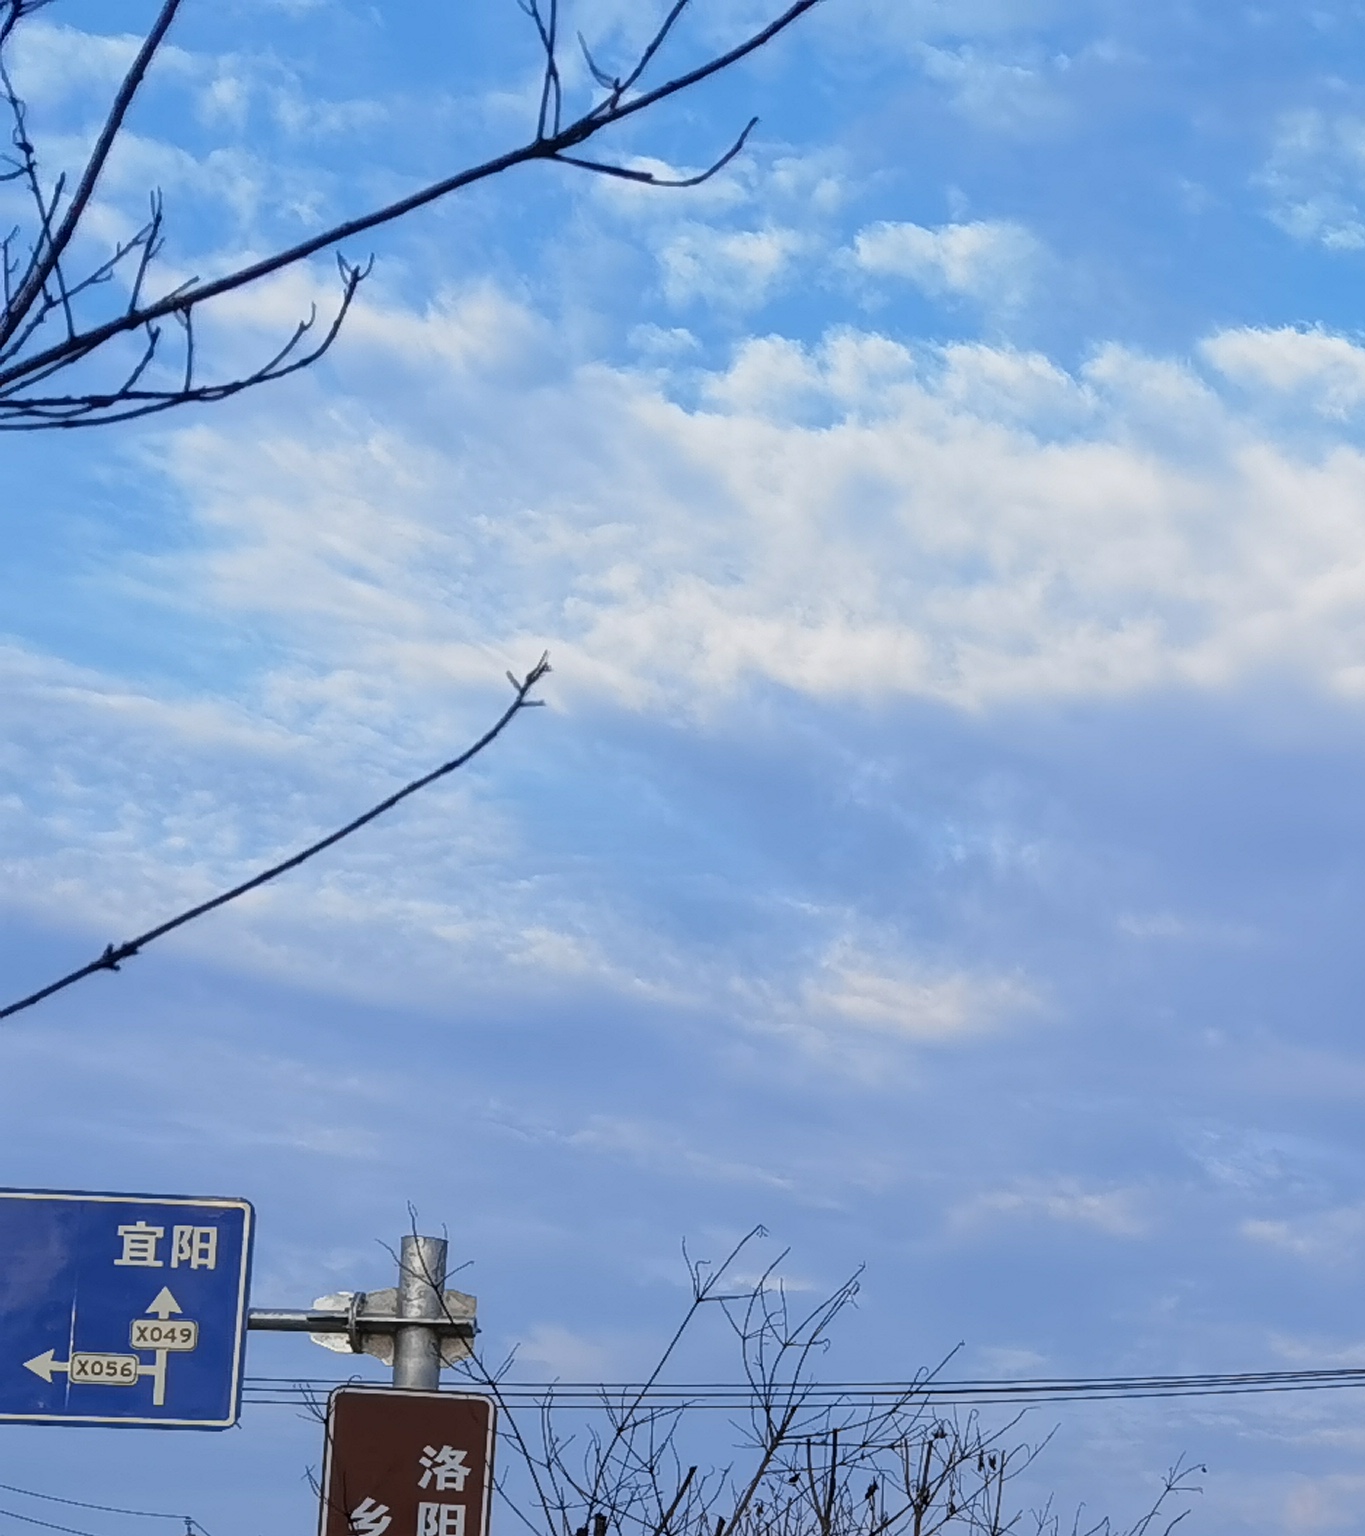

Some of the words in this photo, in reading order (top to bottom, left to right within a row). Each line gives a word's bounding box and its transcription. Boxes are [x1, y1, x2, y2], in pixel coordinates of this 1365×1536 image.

[114, 1221, 217, 1270] 宜阳
[135, 1326, 192, 1343] X049
[76, 1359, 133, 1377] X056
